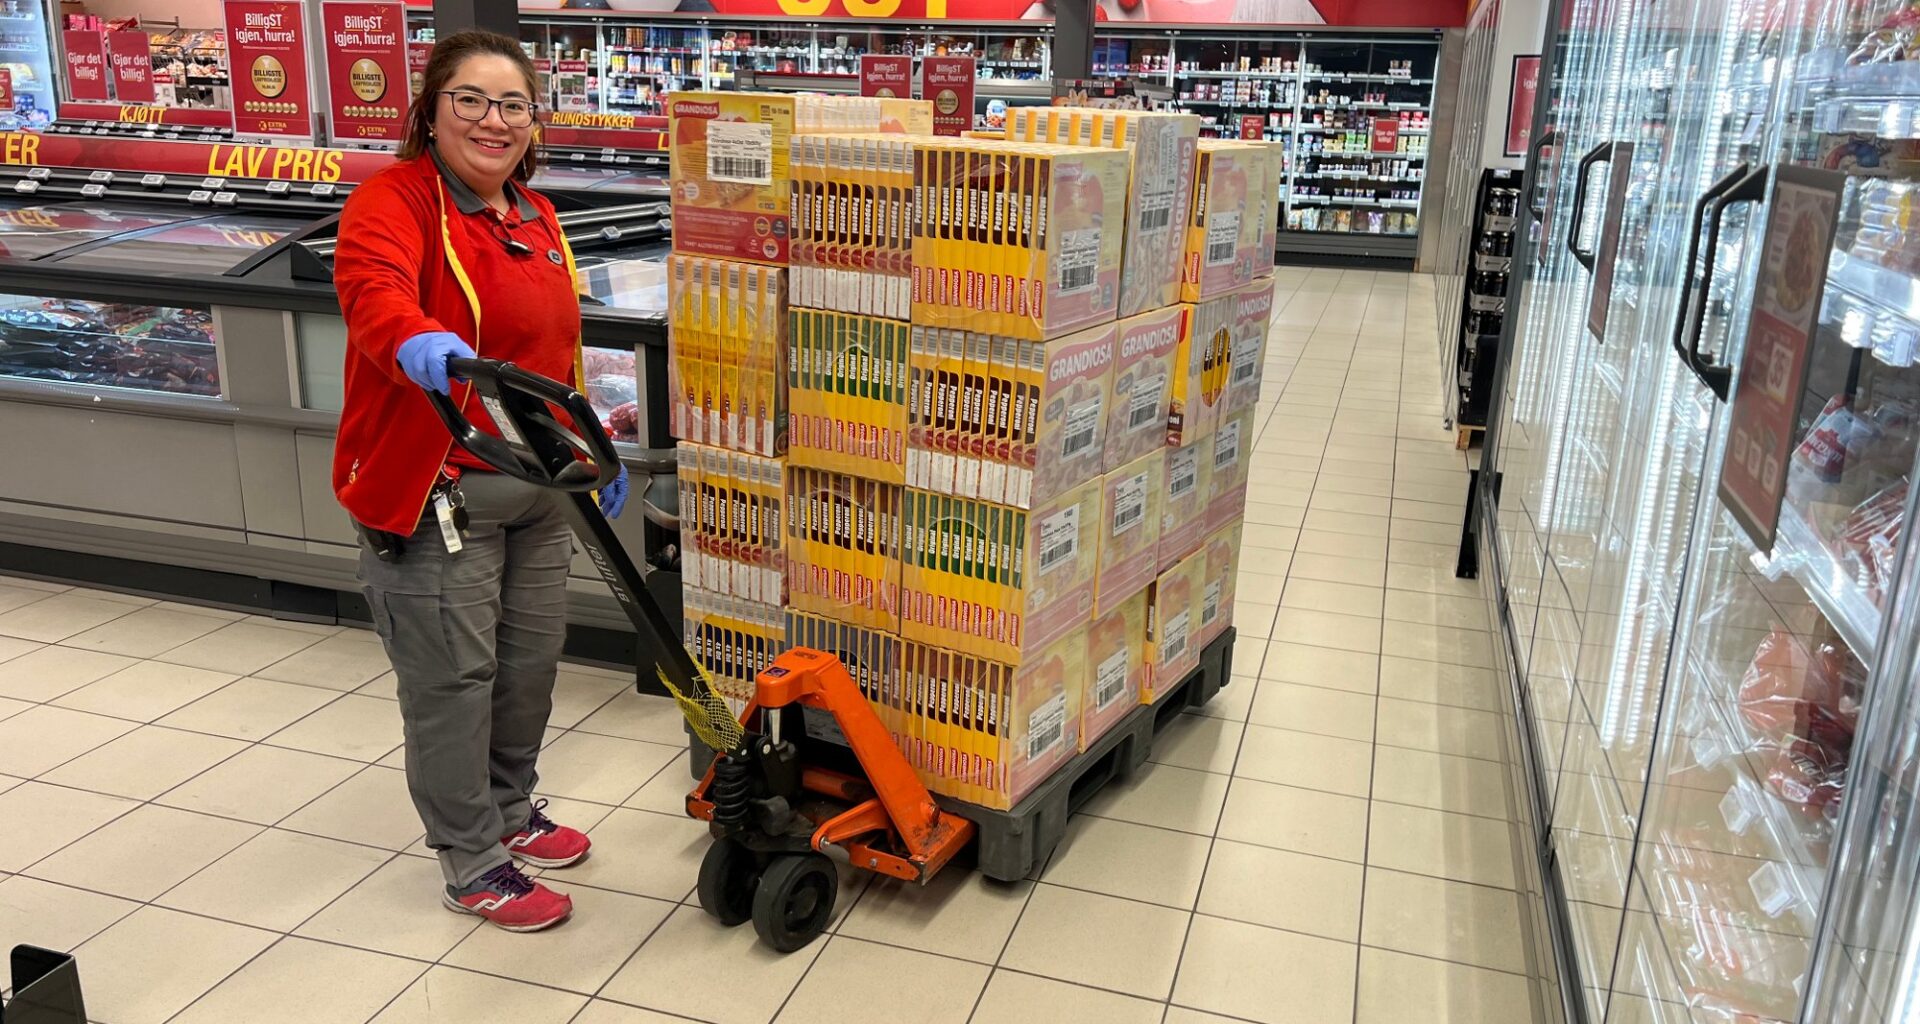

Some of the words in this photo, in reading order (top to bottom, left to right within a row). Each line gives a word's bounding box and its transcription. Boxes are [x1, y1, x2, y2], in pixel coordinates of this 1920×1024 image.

[245, 13, 282, 27] BilligST
[344, 15, 382, 31] BilligST
[235, 28, 263, 43] igjen,
[265, 29, 295, 43] hurra!
[334, 31, 362, 47] igjen,
[364, 32, 396, 46] hurra!
[68, 52, 85, 65] Gjør
[87, 53, 102, 64] det
[113, 53, 132, 66] Gjør
[133, 54, 149, 66] det
[74, 67, 99, 80] billig!
[120, 68, 145, 82] billig!
[254, 69, 282, 78] BILLIGSTE
[352, 73, 382, 82] BILLIGSTE
[120, 106, 167, 123] KJØTT
[552, 112, 635, 128] RUNDSTYKKER
[674, 103, 718, 115] GRANDIOSA
[0, 133, 40, 165] ER
[208, 145, 267, 179] LAV
[272, 147, 344, 183] PRIS
[914, 185, 922, 223] Pepperoni
[928, 186, 936, 224] Pepperoni
[941, 187, 950, 226] Pepperoni
[954, 188, 963, 226] Pepperoni
[968, 188, 977, 227] Pepperoni
[979, 190, 988, 230] Pepperoni
[994, 192, 1003, 231] Pepperoni
[1008, 192, 1017, 232] Pepperoni
[1022, 195, 1032, 235] Pepperoni
[1037, 196, 1047, 236] Pepperoni
[1167, 141, 1192, 279] GRANDIOSA
[1236, 295, 1270, 316] ANDIOSA
[1121, 324, 1177, 358] GRANDIOSA
[825, 350, 833, 376] Original
[837, 352, 845, 378] Original
[849, 354, 857, 380] Original
[872, 358, 880, 384] Original
[884, 360, 892, 386] Original
[1050, 342, 1112, 381] GRANDIOSA
[911, 378, 920, 414] Pepperoni
[924, 381, 932, 416] Pepperoni
[937, 382, 946, 418] Pepperoni
[948, 384, 958, 420] Pepperoni
[962, 386, 972, 422] Pepperoni
[972, 388, 983, 425] Pepperoni
[988, 388, 998, 425] Pepperoni
[1000, 392, 1010, 429] Pepperoni
[1014, 394, 1024, 431] Pepperoni
[1027, 398, 1038, 434] Pepperoni
[905, 524, 913, 549] Original
[928, 529, 936, 554] Original
[941, 531, 949, 556] Original
[952, 534, 960, 559] Original
[964, 536, 972, 561] Original
[976, 538, 985, 564] Original
[989, 542, 997, 567] Original
[1002, 544, 1010, 569] Original
[1014, 548, 1022, 573] Original
[612, 584, 630, 603] BT
